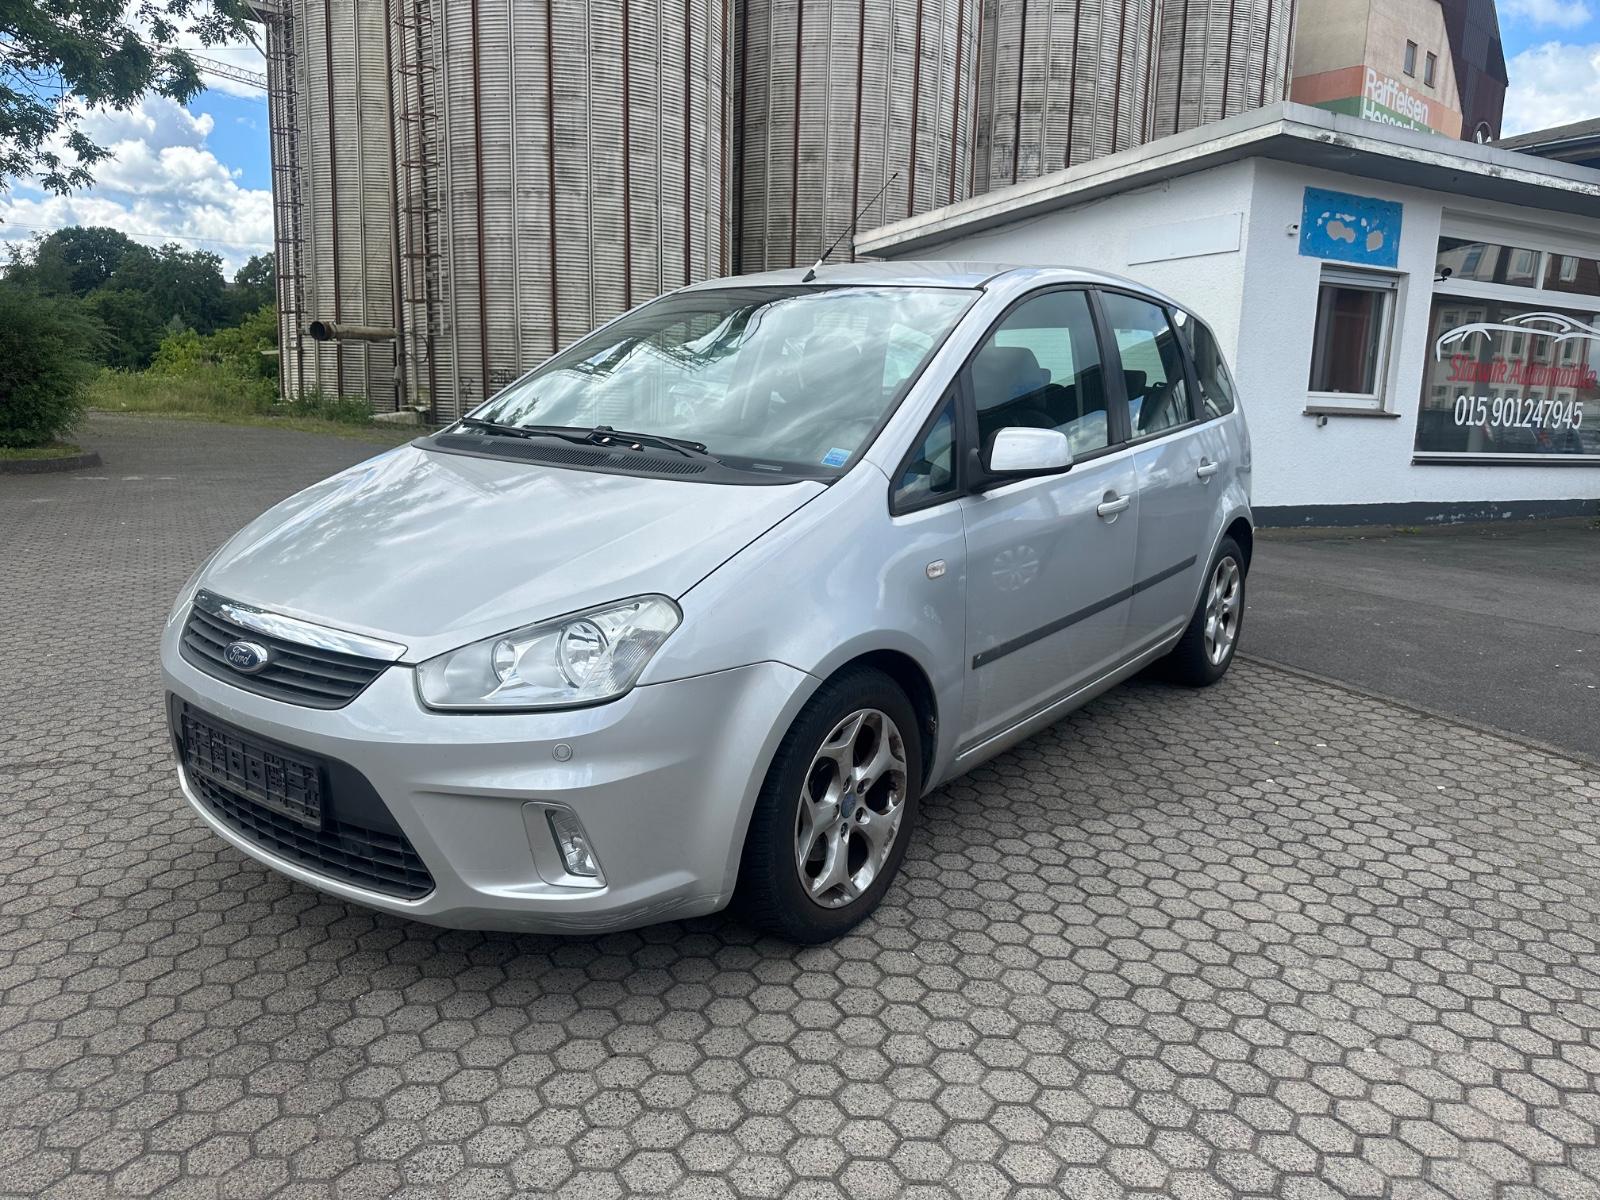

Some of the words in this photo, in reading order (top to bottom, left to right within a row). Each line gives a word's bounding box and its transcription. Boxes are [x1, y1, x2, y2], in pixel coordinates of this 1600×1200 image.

[1365, 67, 1429, 125] Raiffeisen
[1454, 395, 1488, 427] 015
[1491, 397, 1584, 430] 901247945
[230, 645, 252, 665] Ford
